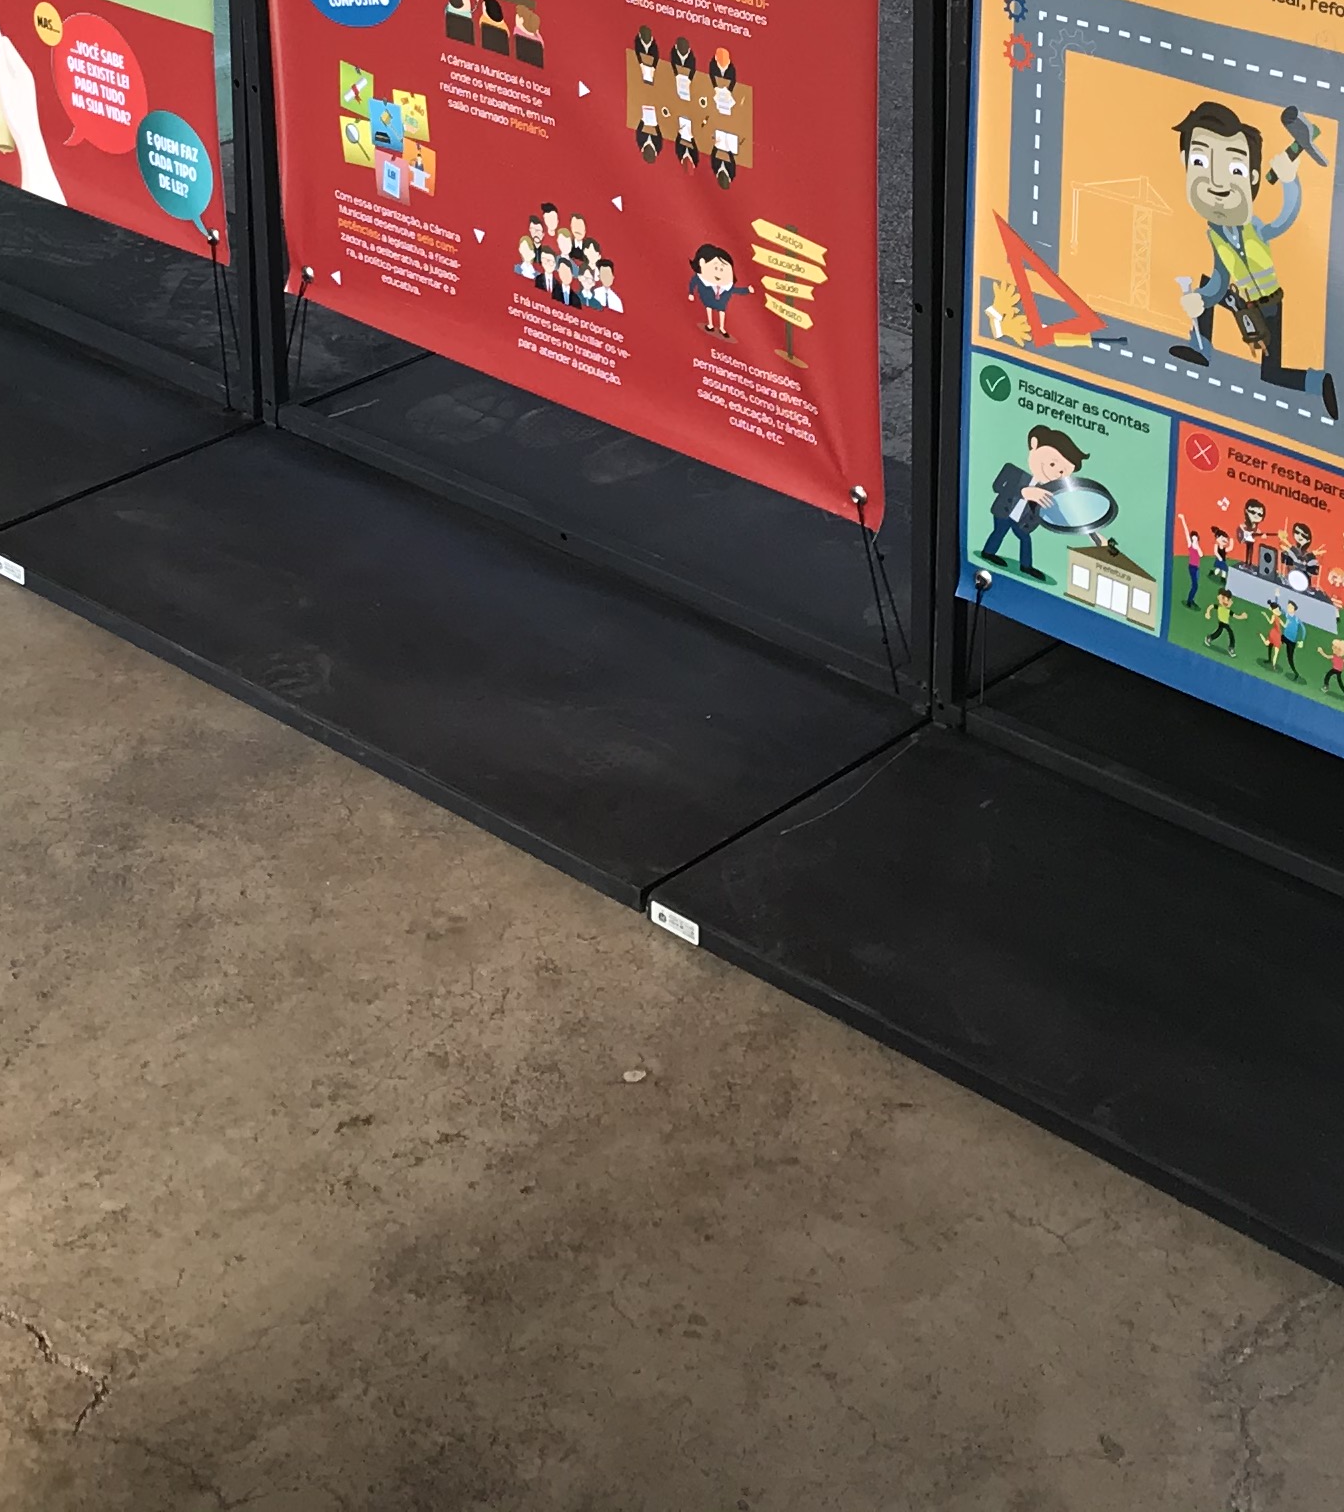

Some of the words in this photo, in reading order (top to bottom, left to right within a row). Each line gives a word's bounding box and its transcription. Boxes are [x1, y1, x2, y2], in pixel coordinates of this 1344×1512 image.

[67, 55, 86, 72] QUE
[87, 62, 116, 84] EXISTE
[116, 73, 130, 90] LEI
[101, 49, 125, 70] SABE
[74, 76, 99, 96] PARA
[100, 84, 125, 106] TUDO
[71, 92, 85, 109] NA
[86, 97, 105, 116] SUA
[105, 103, 132, 126] VIDA?
[775, 232, 803, 250] Justiça
[767, 255, 805, 274] Educação
[775, 282, 799, 294] Saúde
[772, 300, 802, 322] Trânsito
[1017, 396, 1037, 412] da
[1036, 401, 1110, 436] prefeitura.
[1018, 380, 1079, 415] Fiscalizar
[1082, 404, 1099, 417] as
[1102, 407, 1150, 434] contas
[1227, 447, 1268, 470] Fazer
[1271, 461, 1311, 488] festa
[1227, 467, 1236, 479] a
[1238, 469, 1331, 513] comunidade.
